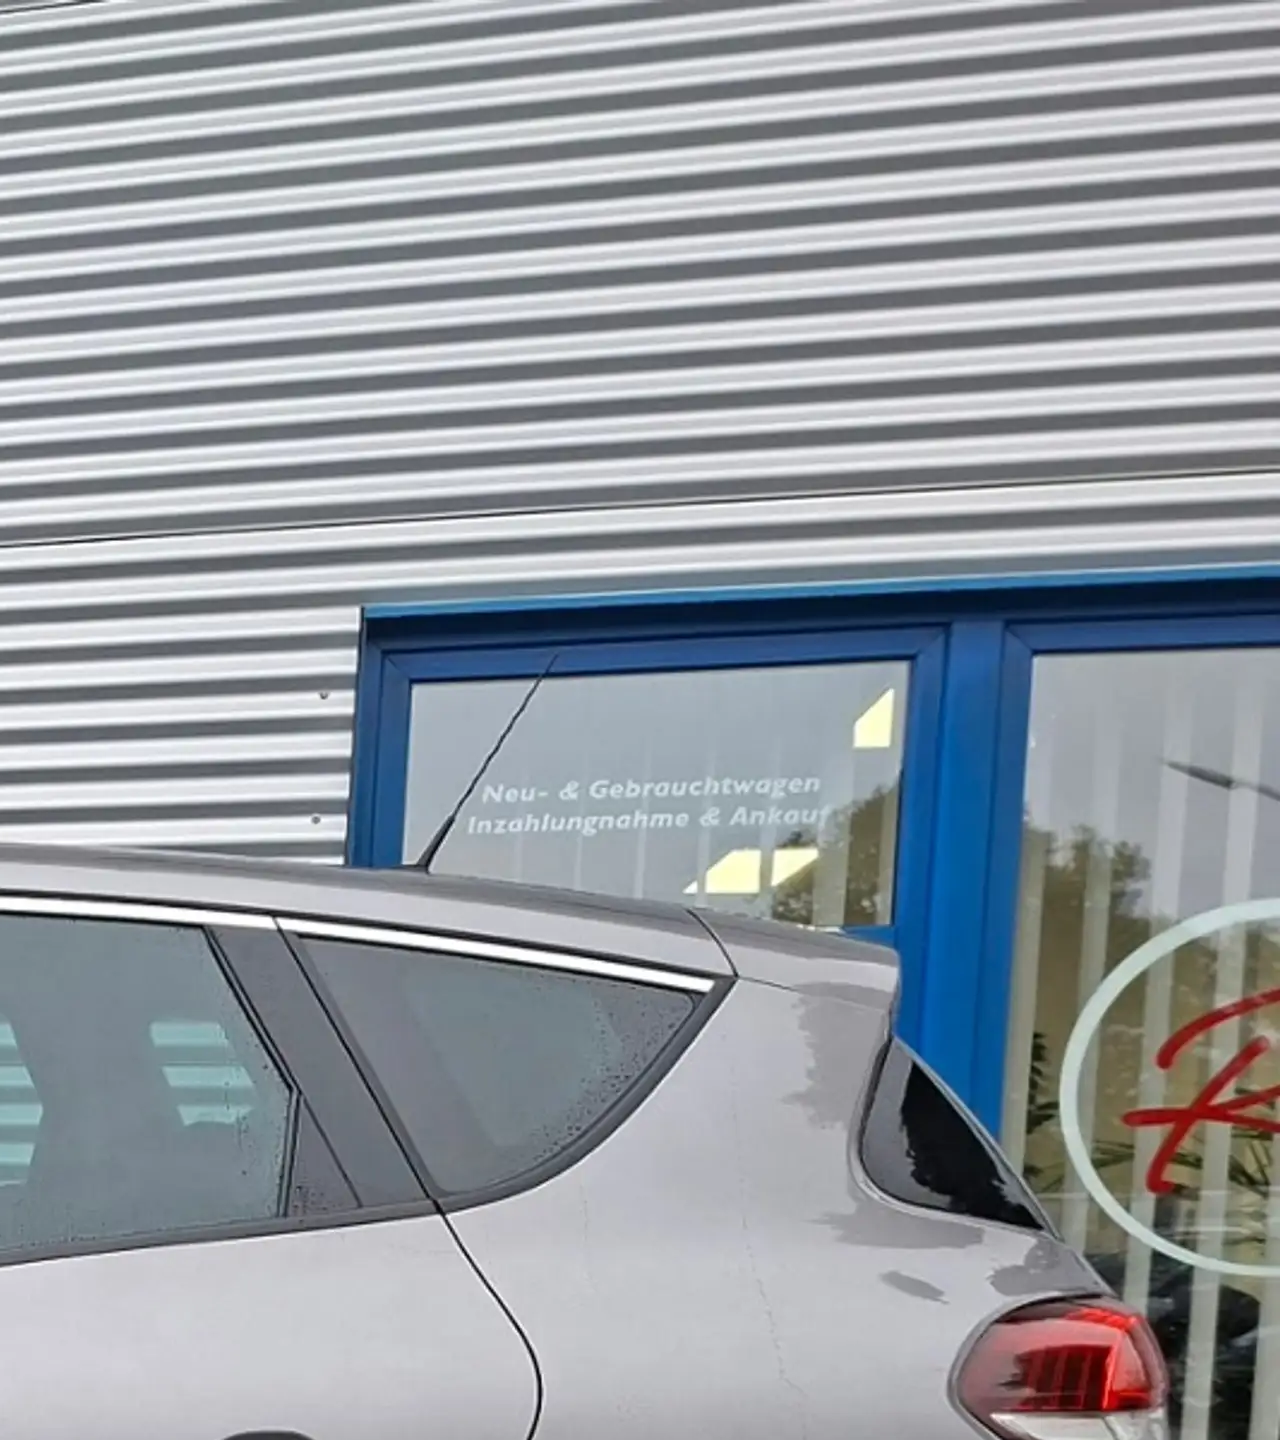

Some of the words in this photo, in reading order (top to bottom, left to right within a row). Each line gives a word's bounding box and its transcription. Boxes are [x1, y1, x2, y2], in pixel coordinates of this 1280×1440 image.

[482, 783, 549, 804] Neu-
[559, 780, 580, 801] &
[589, 776, 821, 800] Gebrauchtwagen
[468, 809, 690, 837] Inzahlungnahme
[699, 806, 721, 828] &
[729, 803, 833, 827] Ankauf
